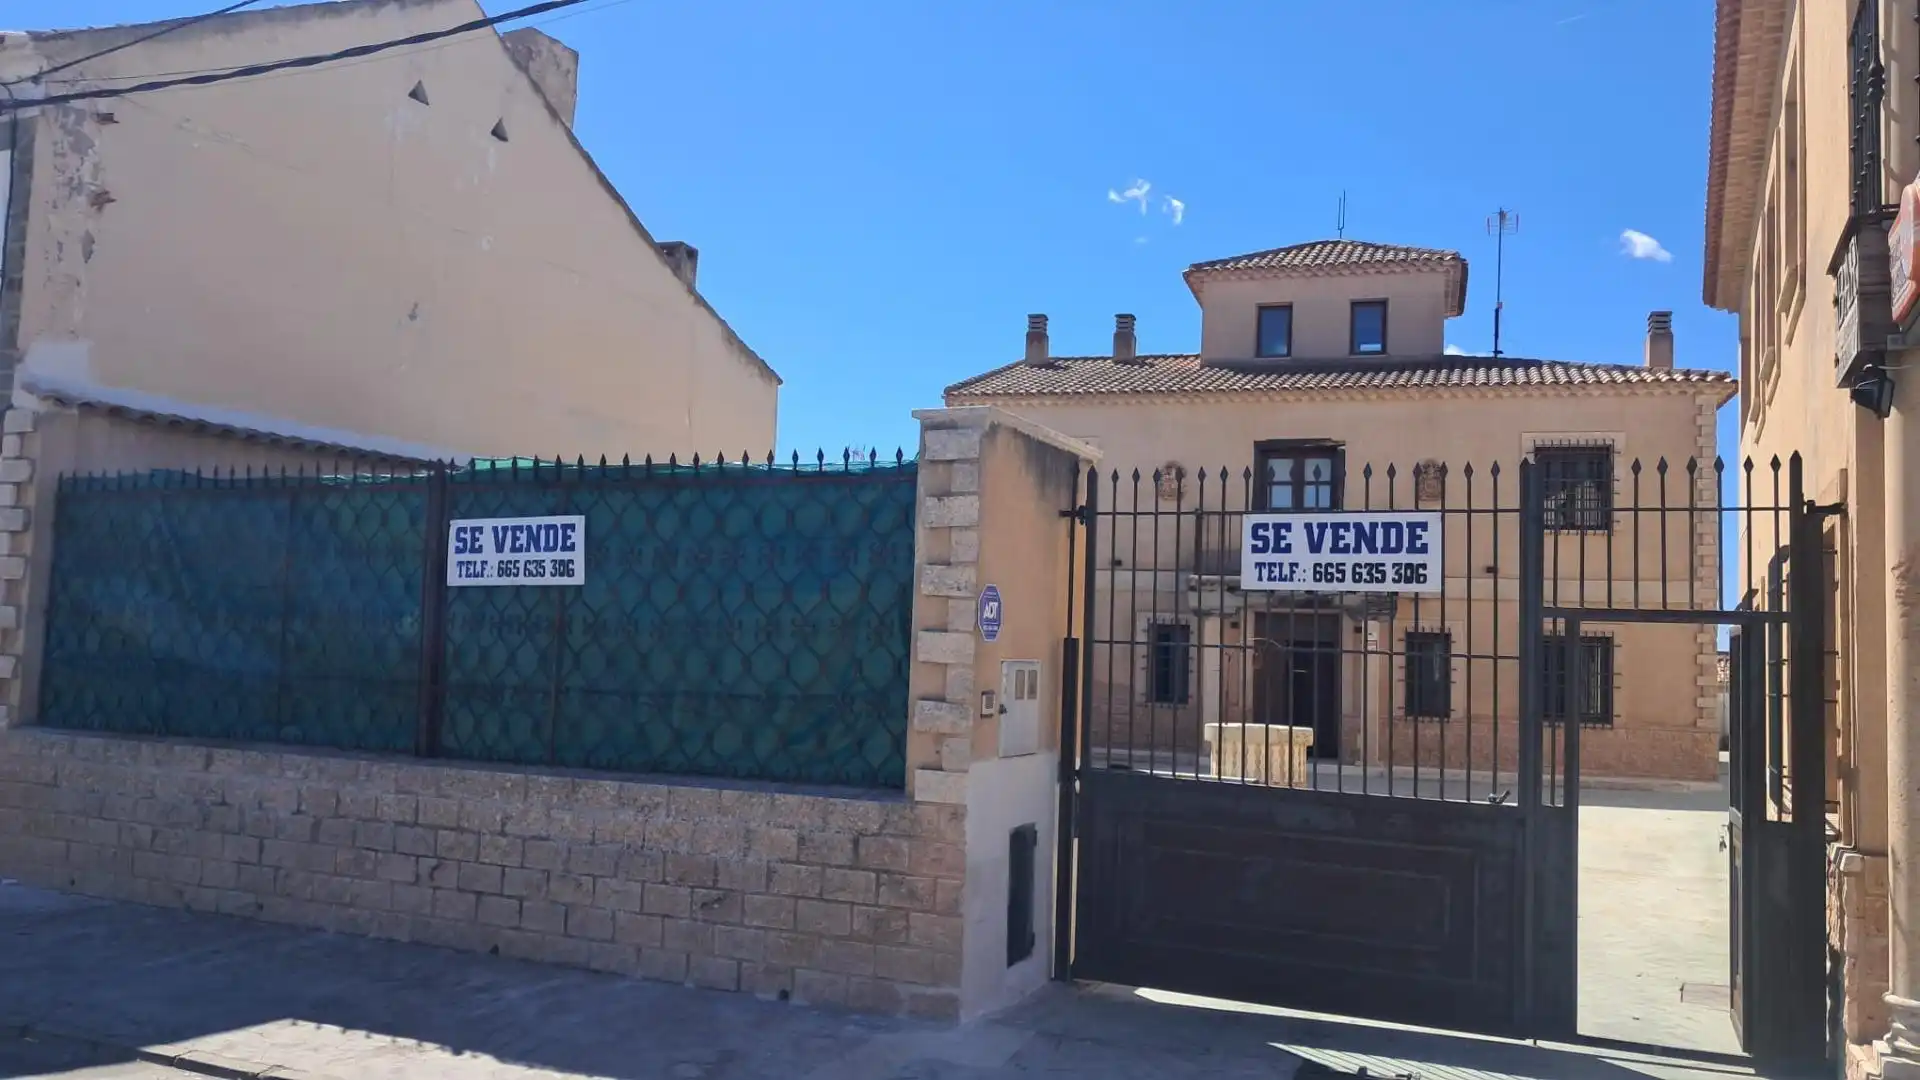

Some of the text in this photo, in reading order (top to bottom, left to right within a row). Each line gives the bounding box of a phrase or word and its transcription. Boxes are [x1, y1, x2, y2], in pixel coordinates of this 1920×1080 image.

[454, 523, 576, 554] SE VENDE
[1251, 521, 1428, 554] SE VENDE
[456, 559, 575, 578] TELF.: 665 635 306
[1254, 562, 1427, 584] TELF.: 665 635 306
[983, 602, 998, 619] ADT
